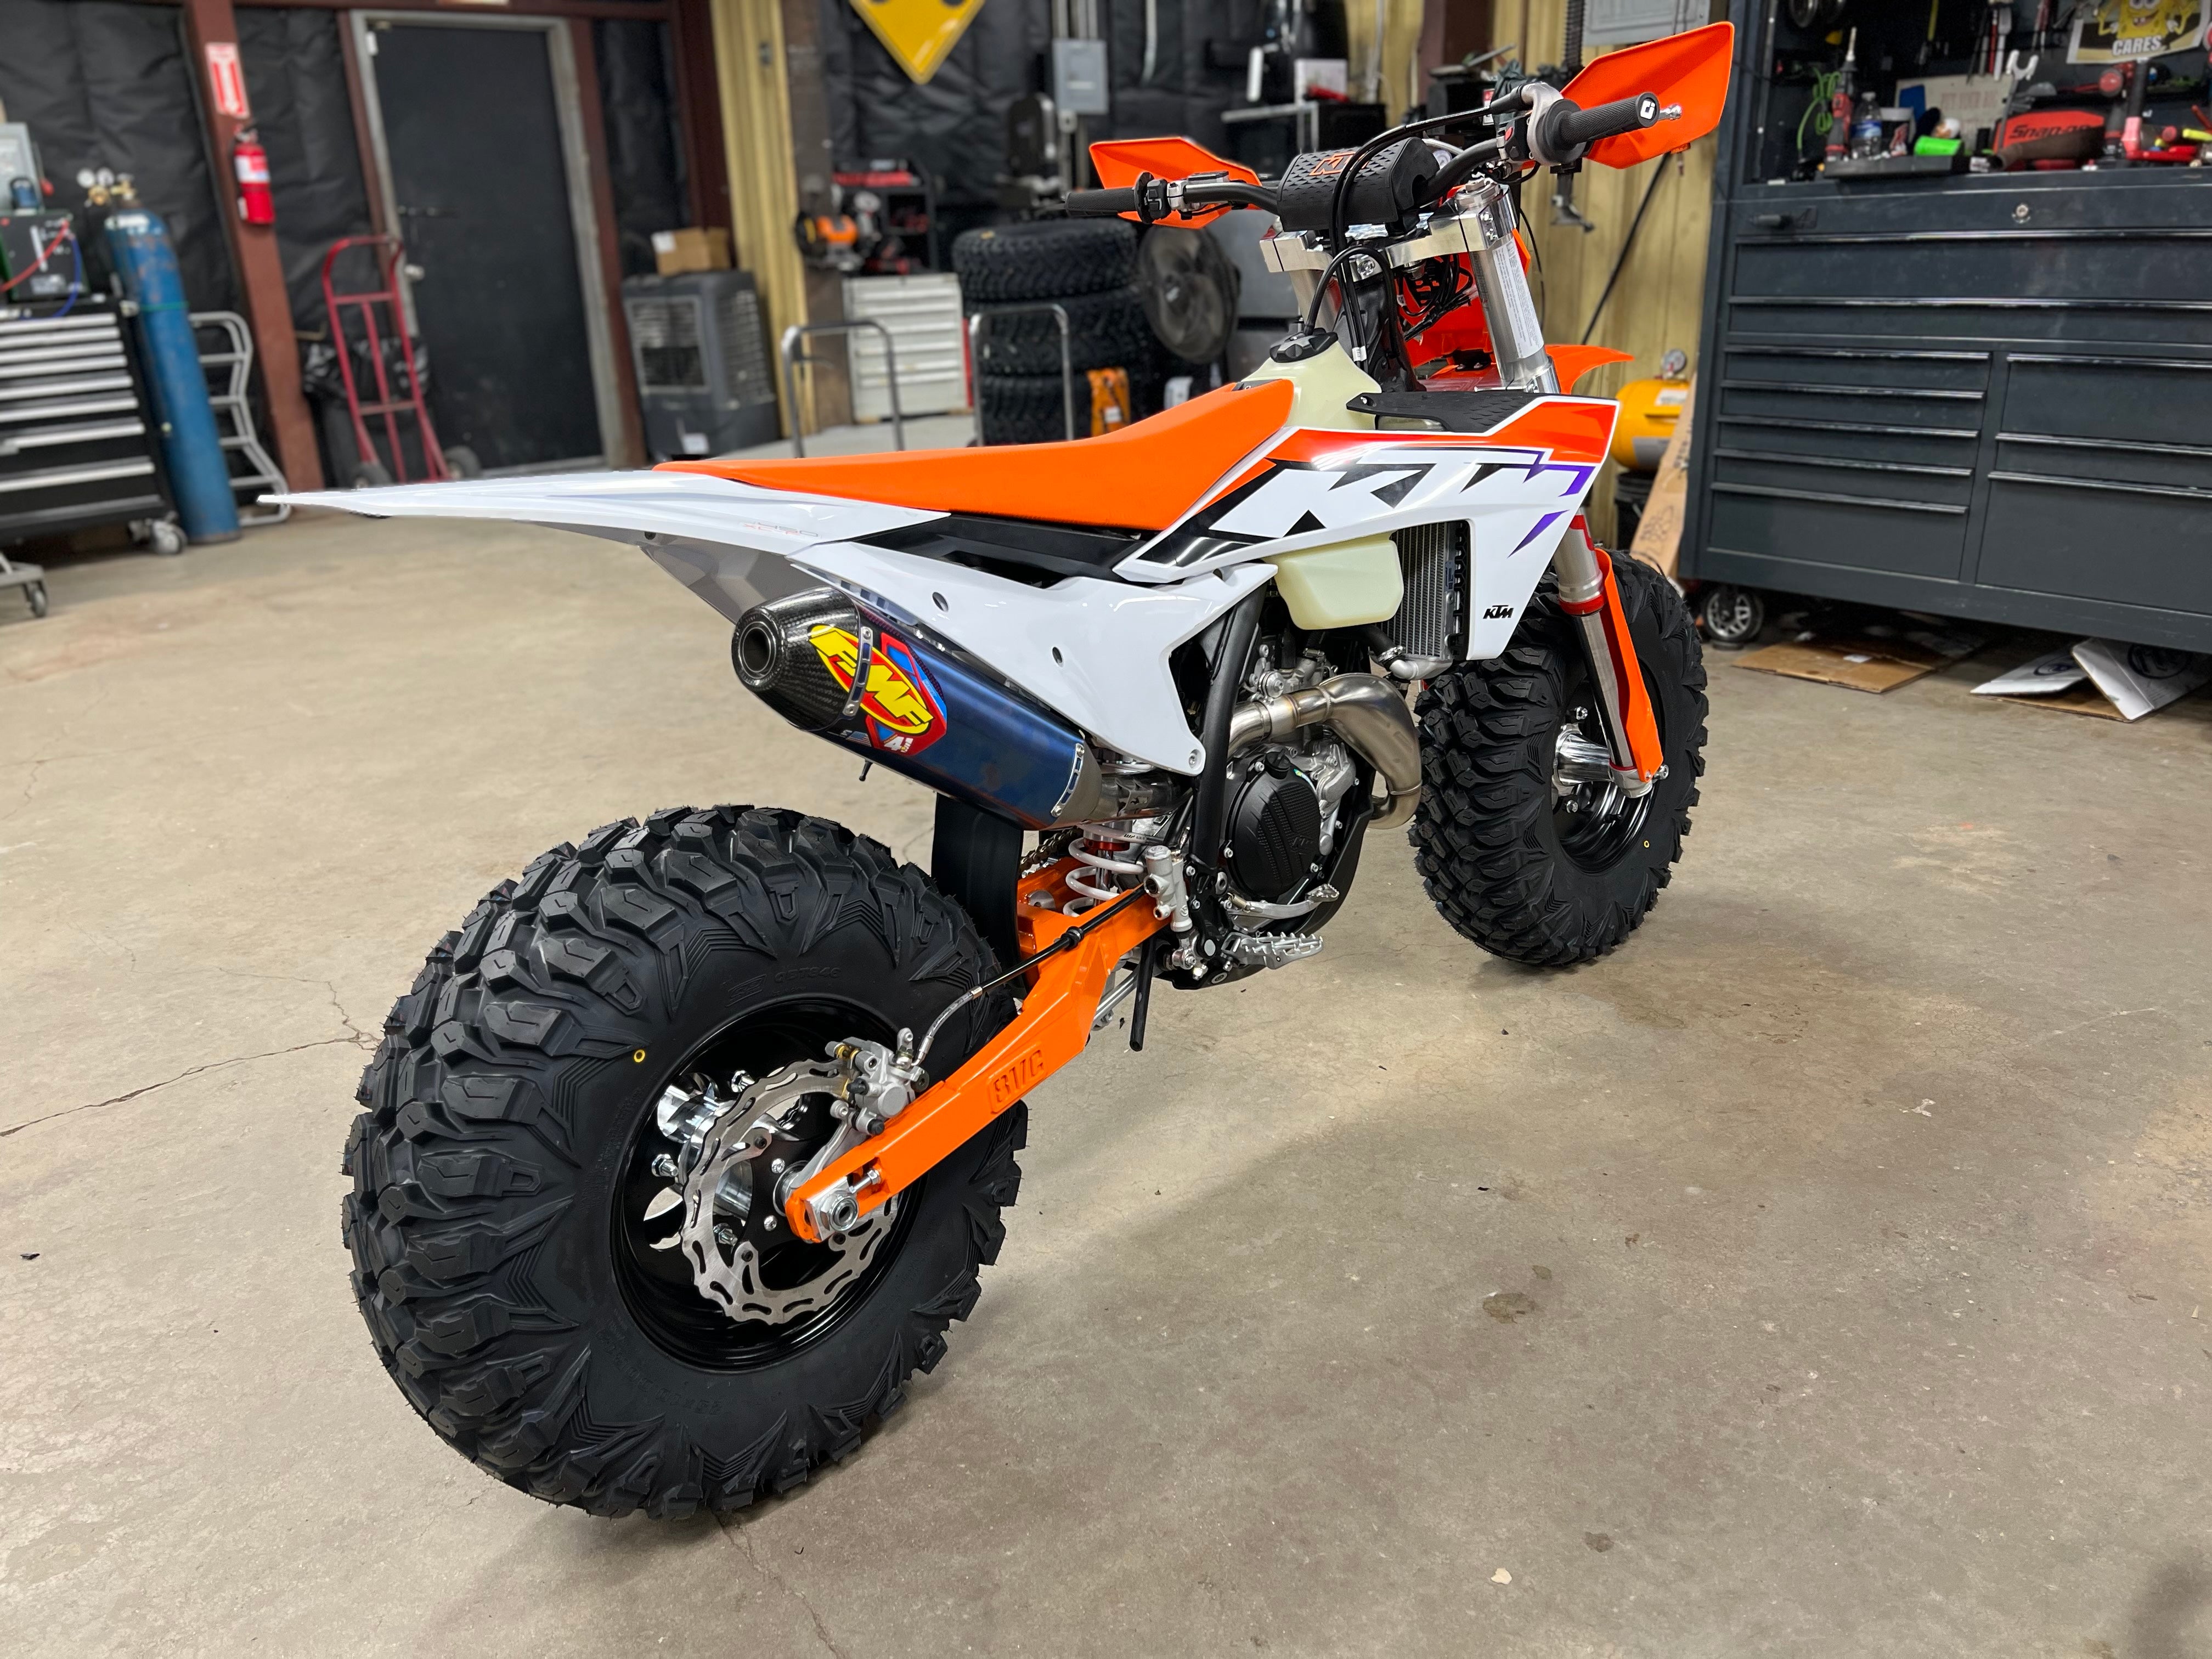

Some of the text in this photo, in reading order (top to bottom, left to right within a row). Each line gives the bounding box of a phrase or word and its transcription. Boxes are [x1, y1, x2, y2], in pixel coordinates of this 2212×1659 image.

[2112, 36, 2162, 56] CARES
[1483, 604, 1514, 620] KTM
[809, 630, 934, 726] FMF
